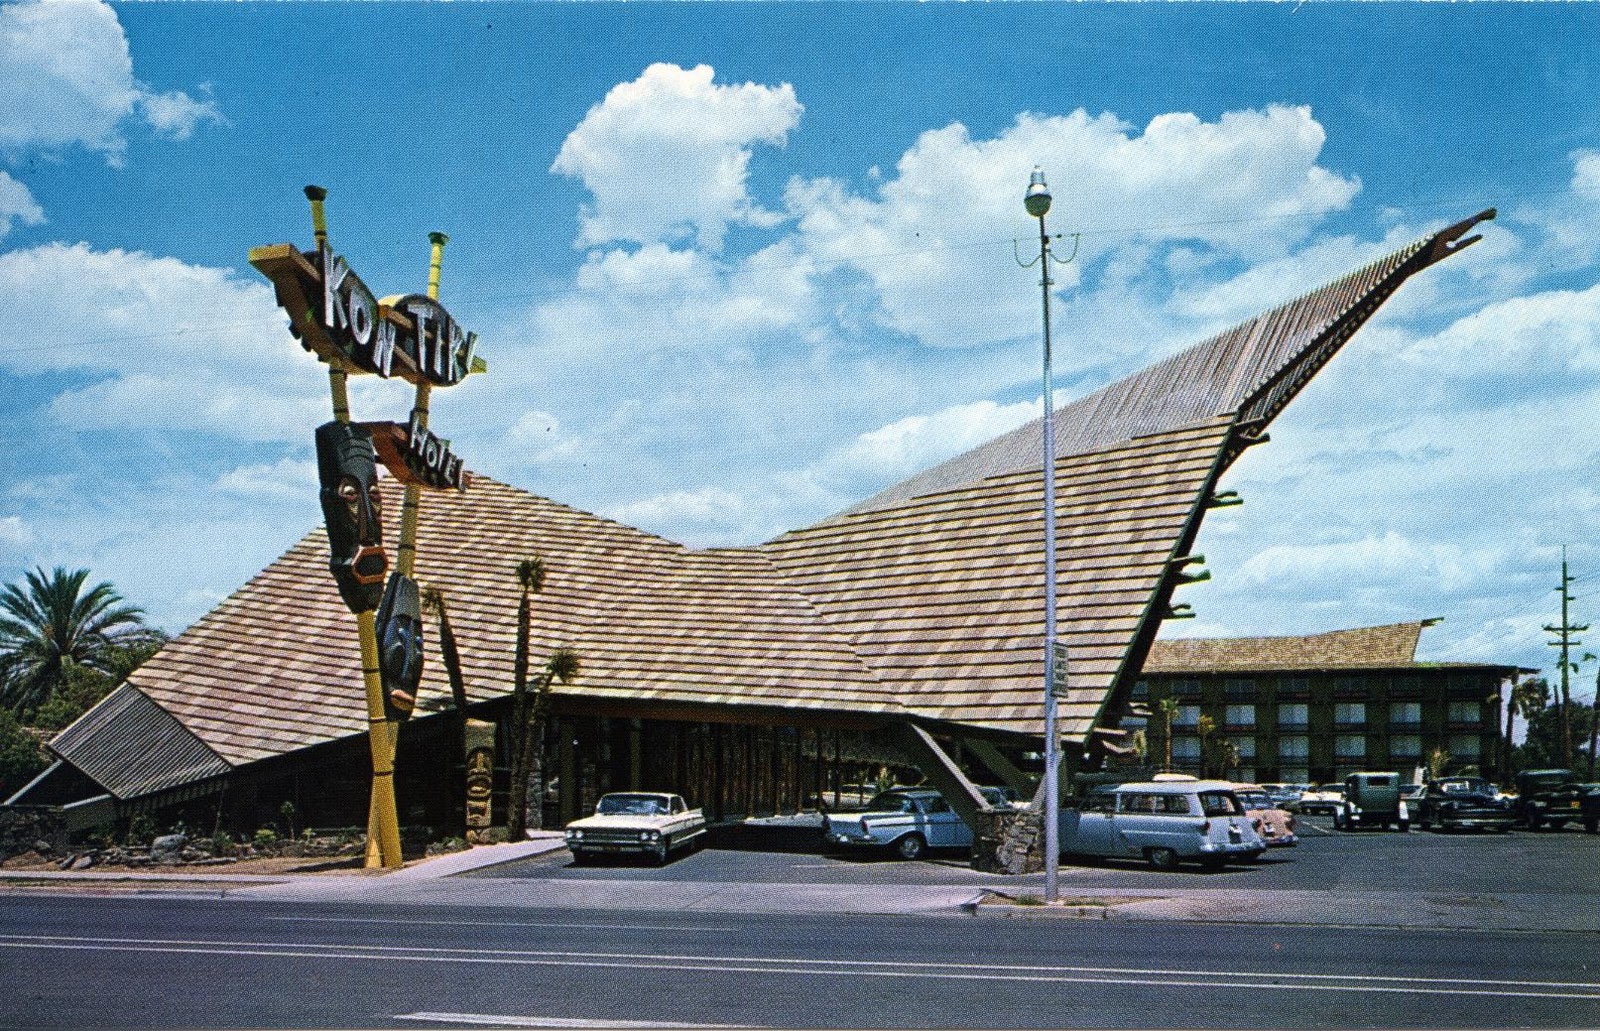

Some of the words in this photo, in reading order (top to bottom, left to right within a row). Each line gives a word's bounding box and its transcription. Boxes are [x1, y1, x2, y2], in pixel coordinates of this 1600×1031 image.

[322, 242, 396, 378] KON
[407, 303, 477, 382] TIKI
[410, 412, 464, 490] HOTEL
